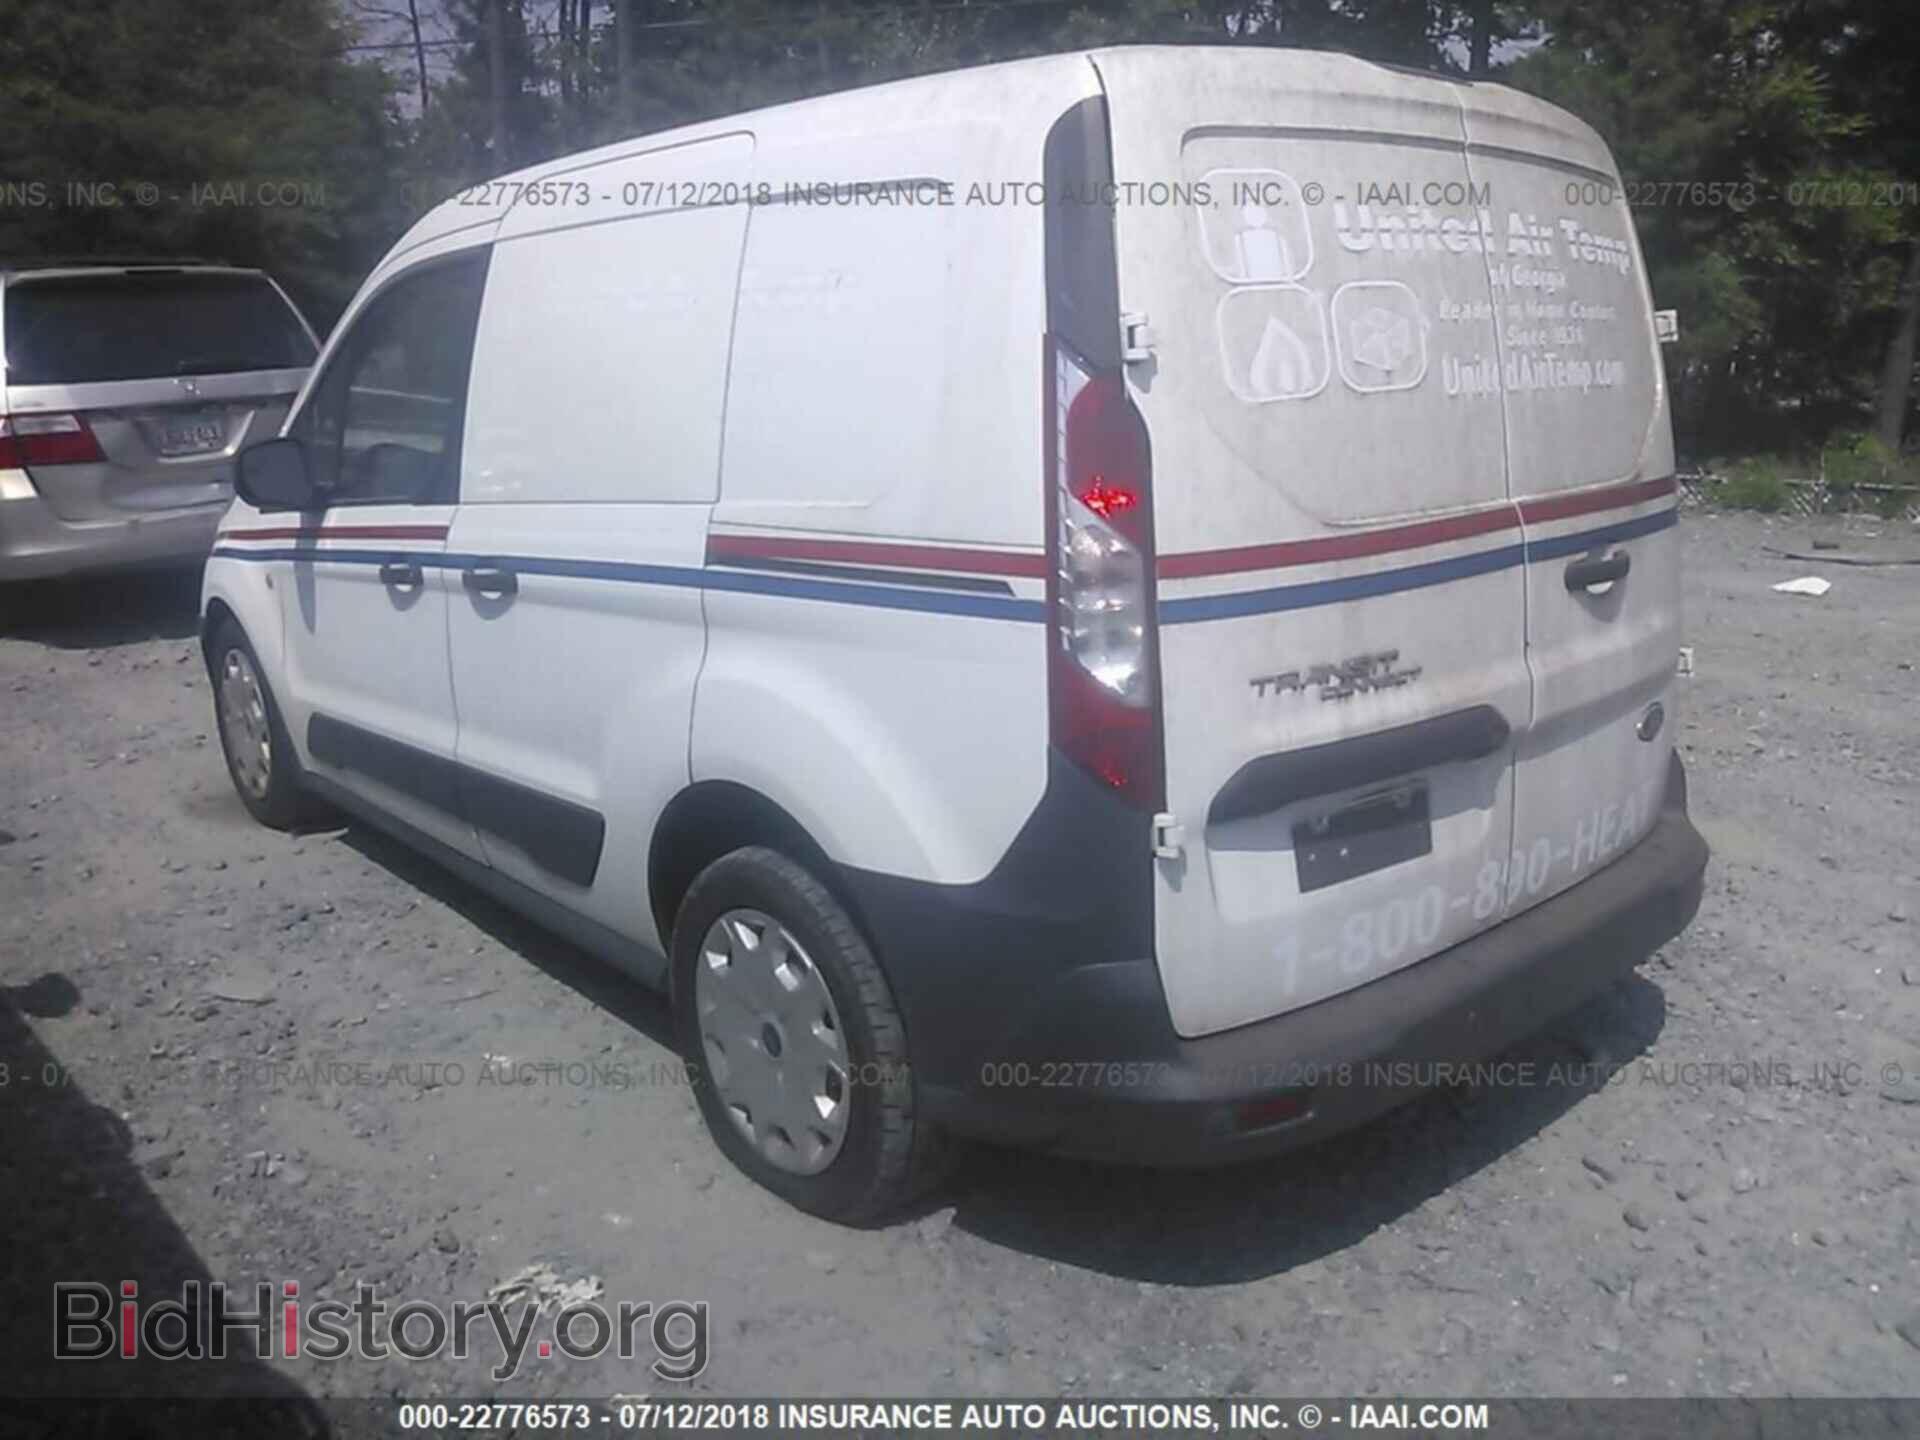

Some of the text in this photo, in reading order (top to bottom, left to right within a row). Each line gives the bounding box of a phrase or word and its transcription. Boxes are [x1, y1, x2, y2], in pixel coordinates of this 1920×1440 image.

[1333, 203, 1631, 275] United Air Temp
